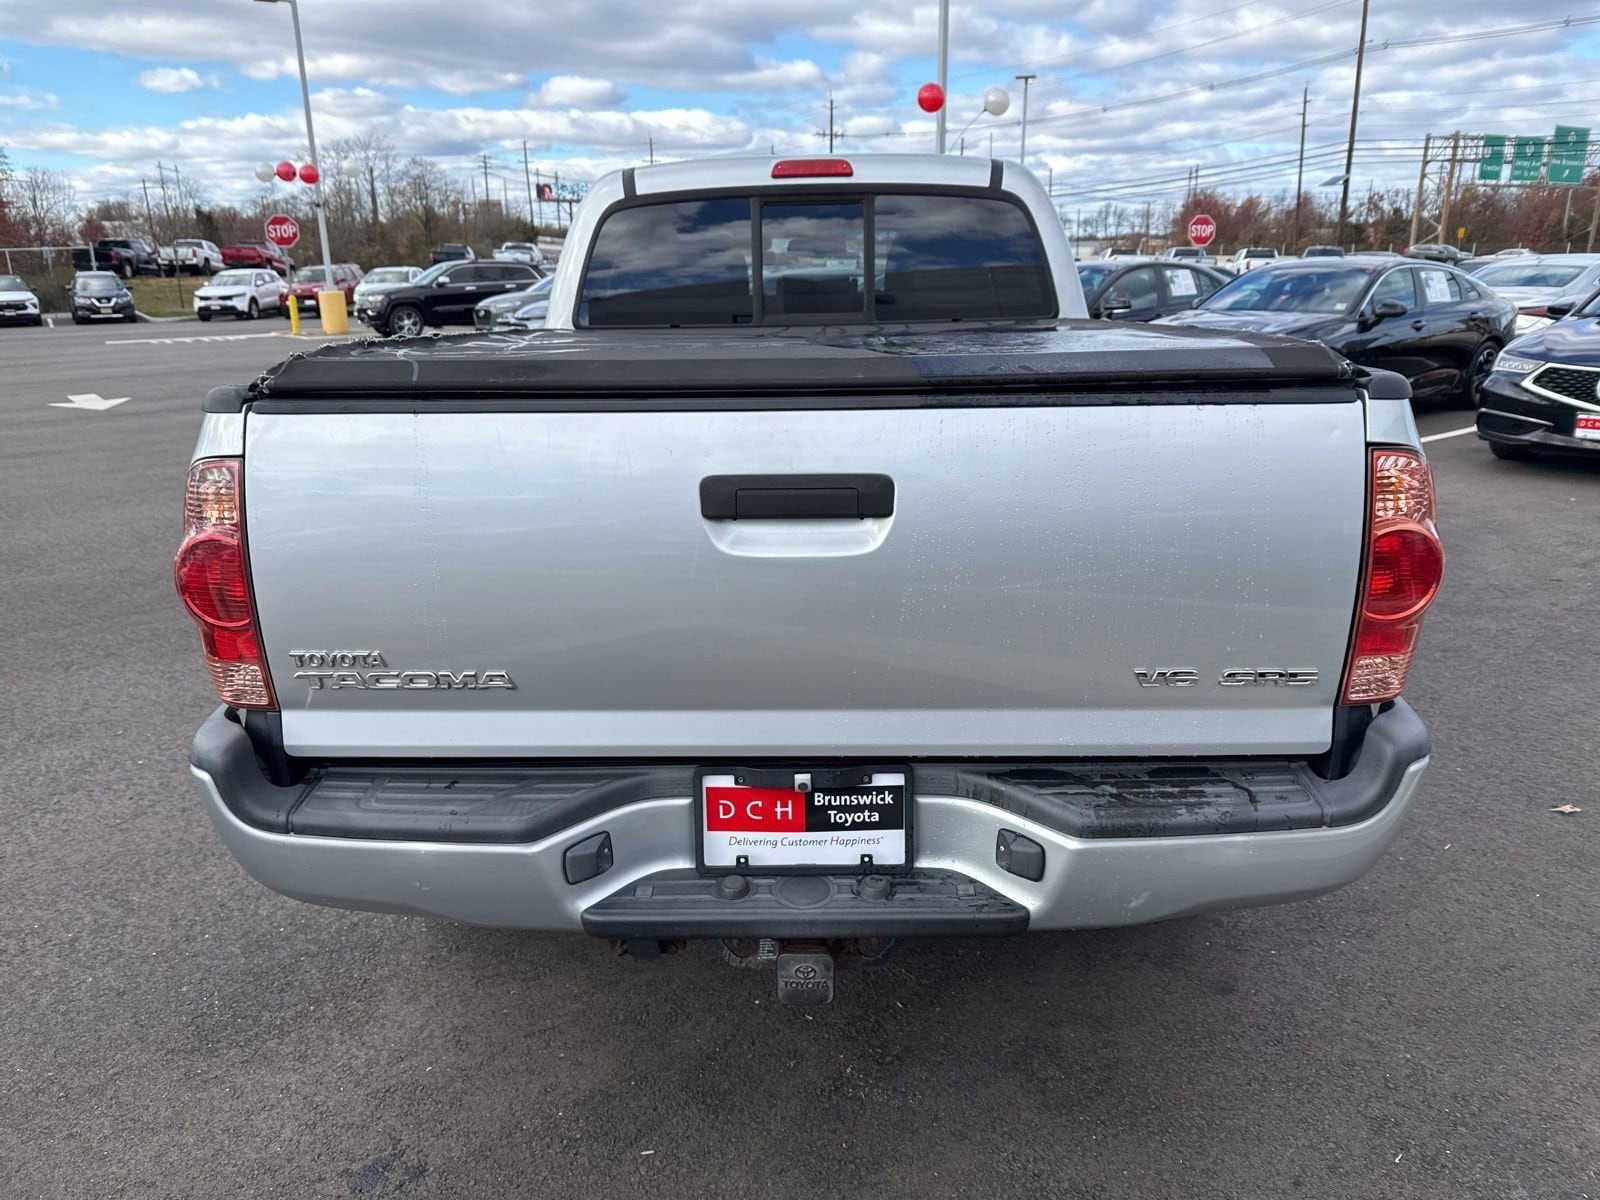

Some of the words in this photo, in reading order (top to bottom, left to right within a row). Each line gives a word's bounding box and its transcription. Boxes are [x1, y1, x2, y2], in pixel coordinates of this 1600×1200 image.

[268, 224, 296, 238] STOP
[1191, 224, 1214, 237] STOP
[289, 650, 388, 668] TOYOTA
[293, 671, 517, 690] TACOMA
[1134, 668, 1199, 687] V6
[814, 791, 894, 806] Brunswick
[827, 810, 880, 827] Toyota
[728, 836, 778, 849] Delivering
[780, 836, 828, 847] Customer
[783, 980, 829, 989] TOYOTA
